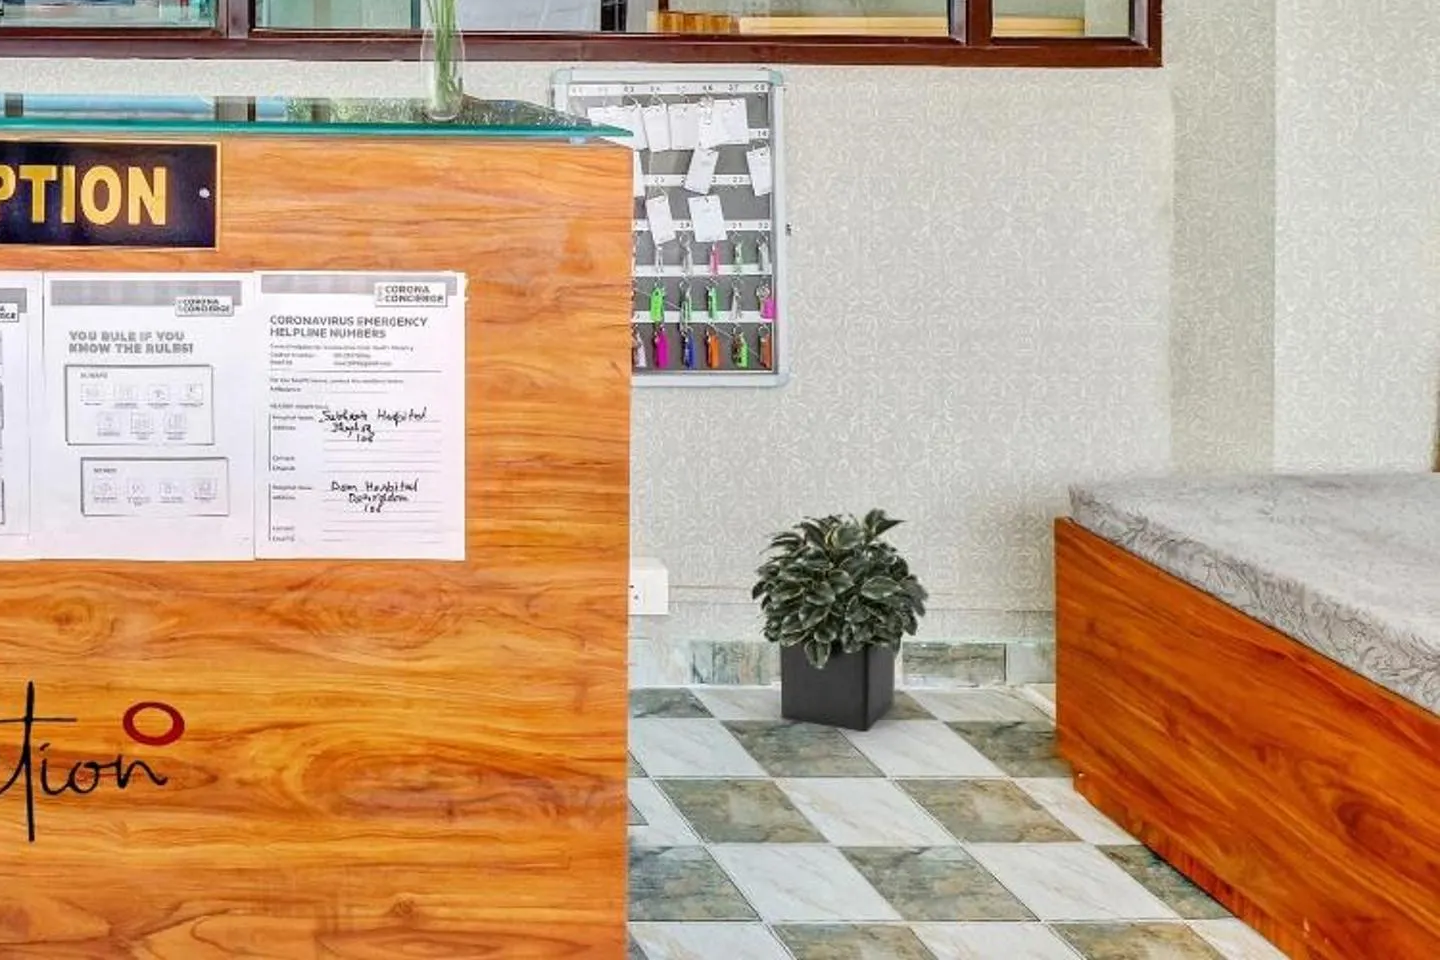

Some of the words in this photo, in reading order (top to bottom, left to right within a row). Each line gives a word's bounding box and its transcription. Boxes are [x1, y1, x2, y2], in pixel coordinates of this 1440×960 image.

[385, 285, 430, 294] CORONA
[270, 315, 354, 327] CORONAVIRUS
[357, 316, 428, 328] EMERGENCY
[68, 330, 97, 341] YOU
[101, 331, 136, 342] RULE
[139, 331, 153, 342] IF
[156, 331, 185, 342] YOU
[270, 328, 327, 338] HELPLINE
[330, 328, 386, 339] NUMBERS
[68, 342, 110, 354] KNOW
[114, 343, 143, 354] THE
